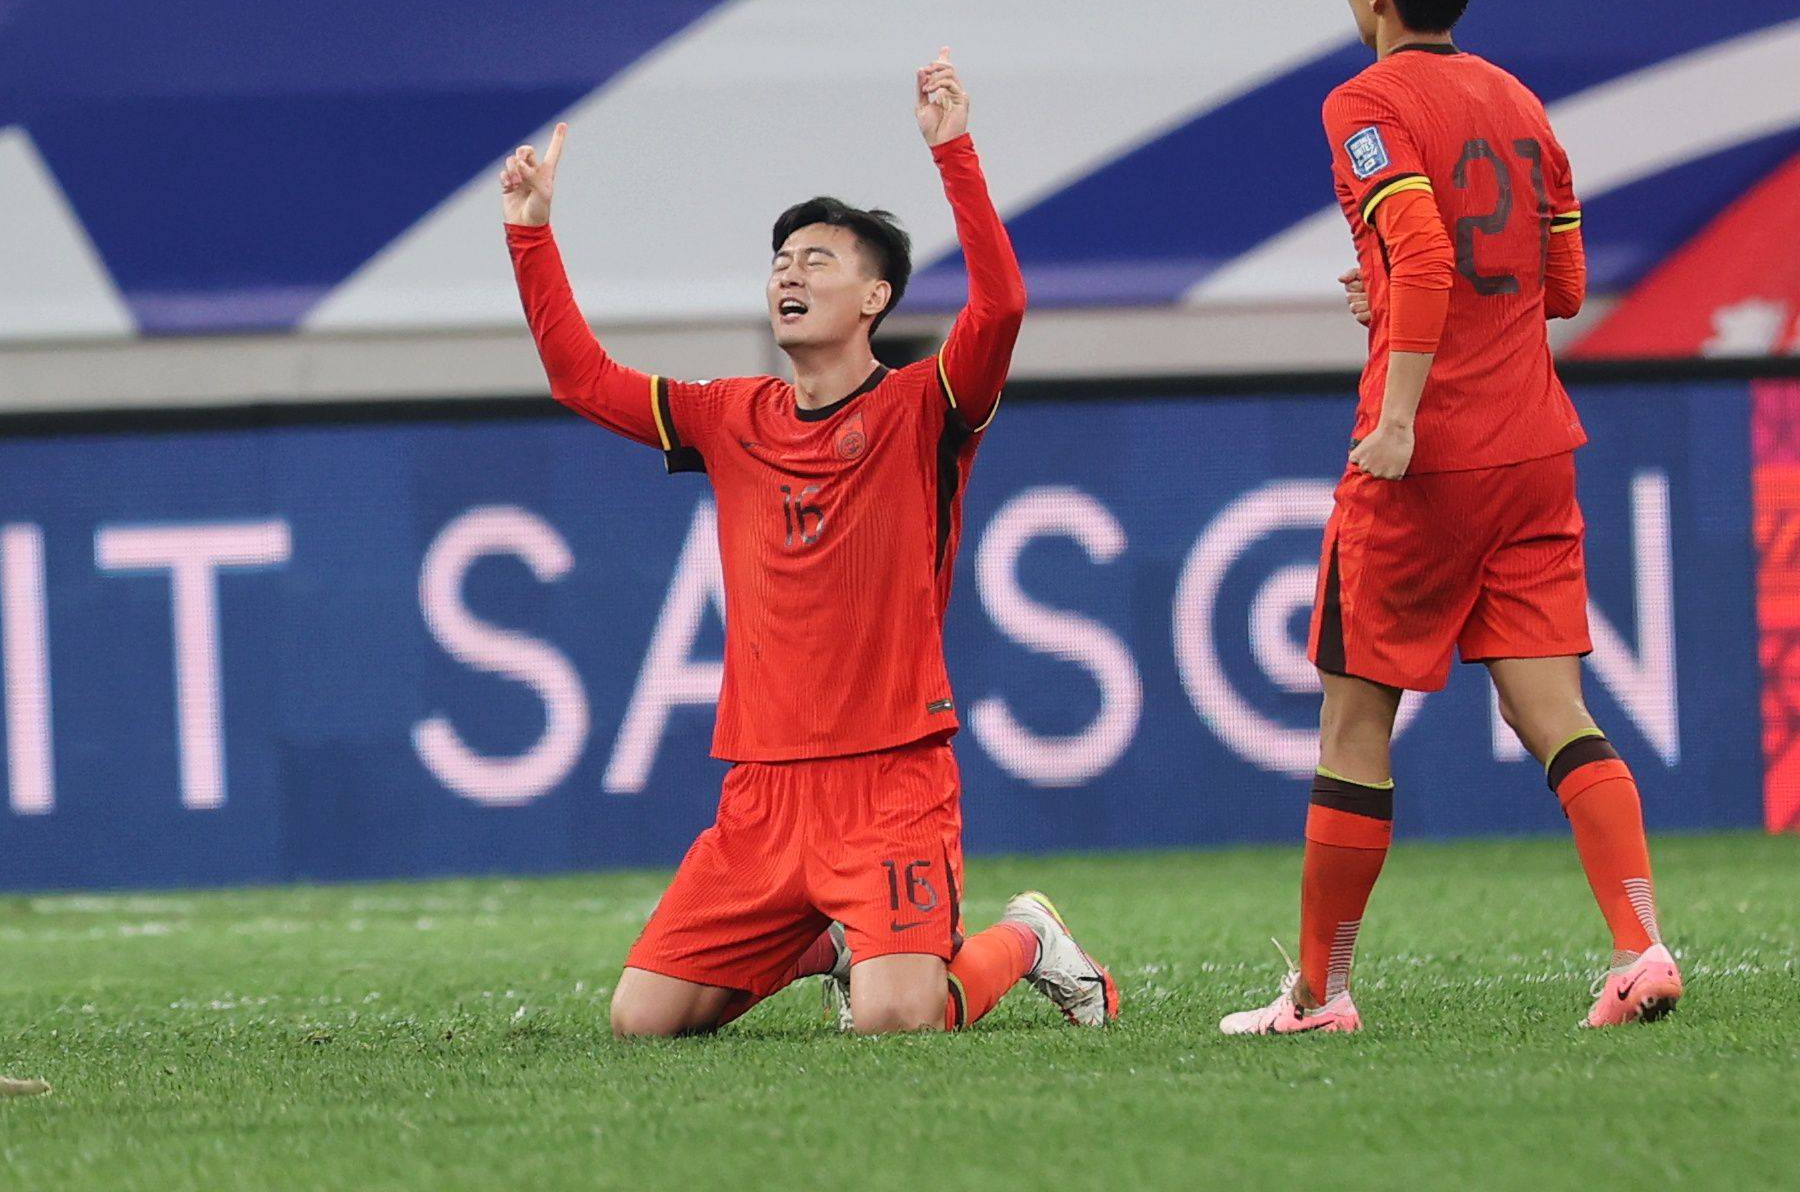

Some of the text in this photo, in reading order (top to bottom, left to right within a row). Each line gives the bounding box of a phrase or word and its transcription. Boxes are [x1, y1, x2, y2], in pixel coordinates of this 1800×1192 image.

[1453, 138, 1549, 296] 21
[779, 484, 825, 548] 16
[411, 466, 1681, 806] SASON
[880, 859, 938, 912] 16
